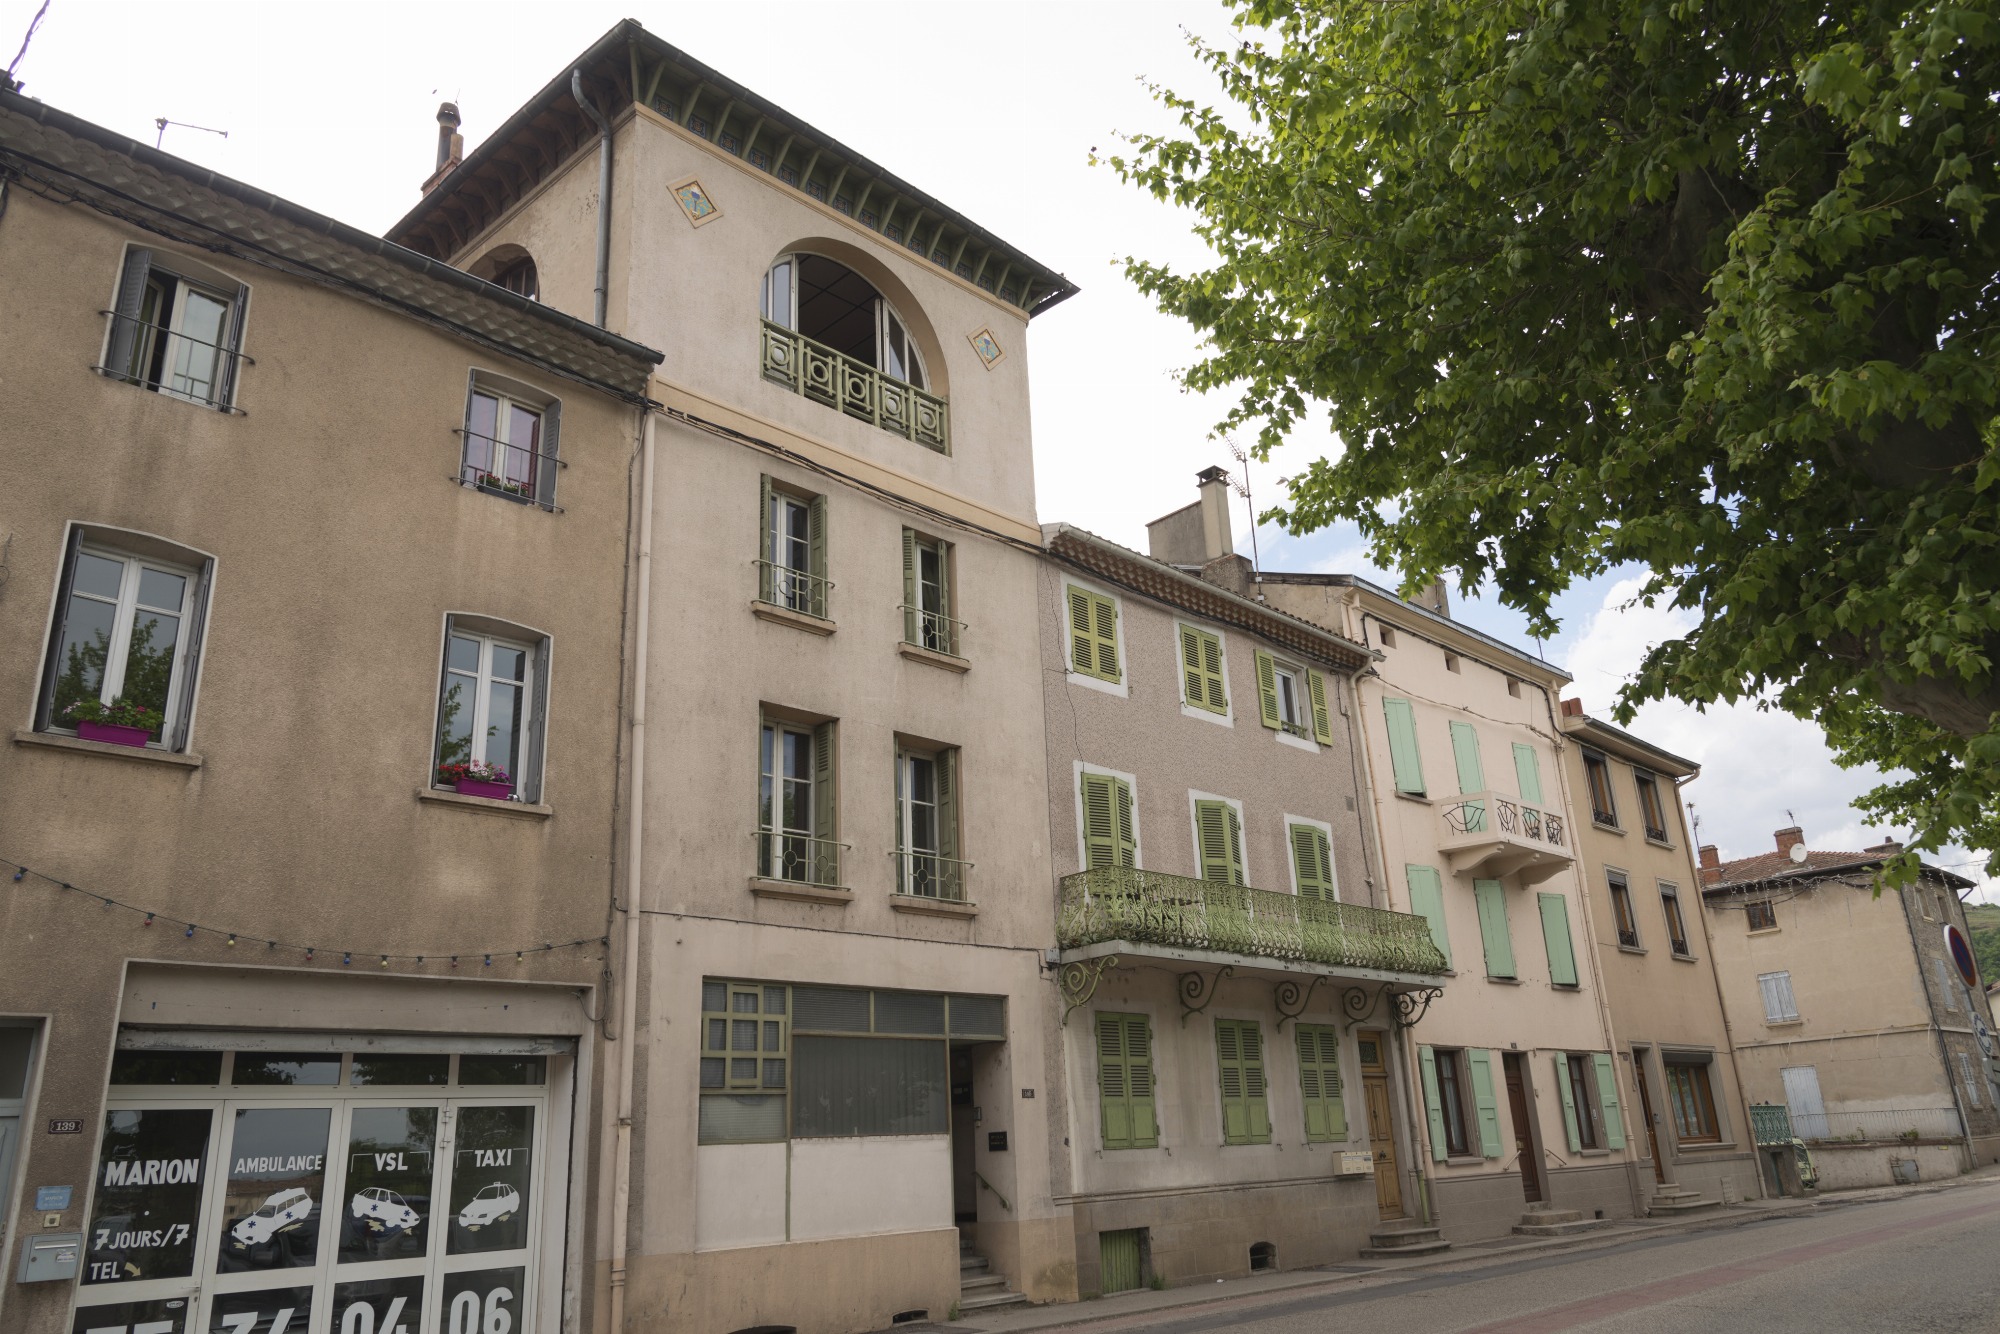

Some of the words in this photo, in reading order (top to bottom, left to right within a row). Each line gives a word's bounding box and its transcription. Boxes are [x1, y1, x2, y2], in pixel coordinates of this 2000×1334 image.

[55, 1121, 76, 1131] 139
[234, 1155, 322, 1174] AMBULANCE
[374, 1152, 408, 1171] VSL
[475, 1149, 513, 1167] TAXI
[104, 1159, 200, 1187] MARION
[94, 1229, 110, 1250] 7
[109, 1224, 190, 1250] JOURS/7
[91, 1262, 121, 1280] TEL
